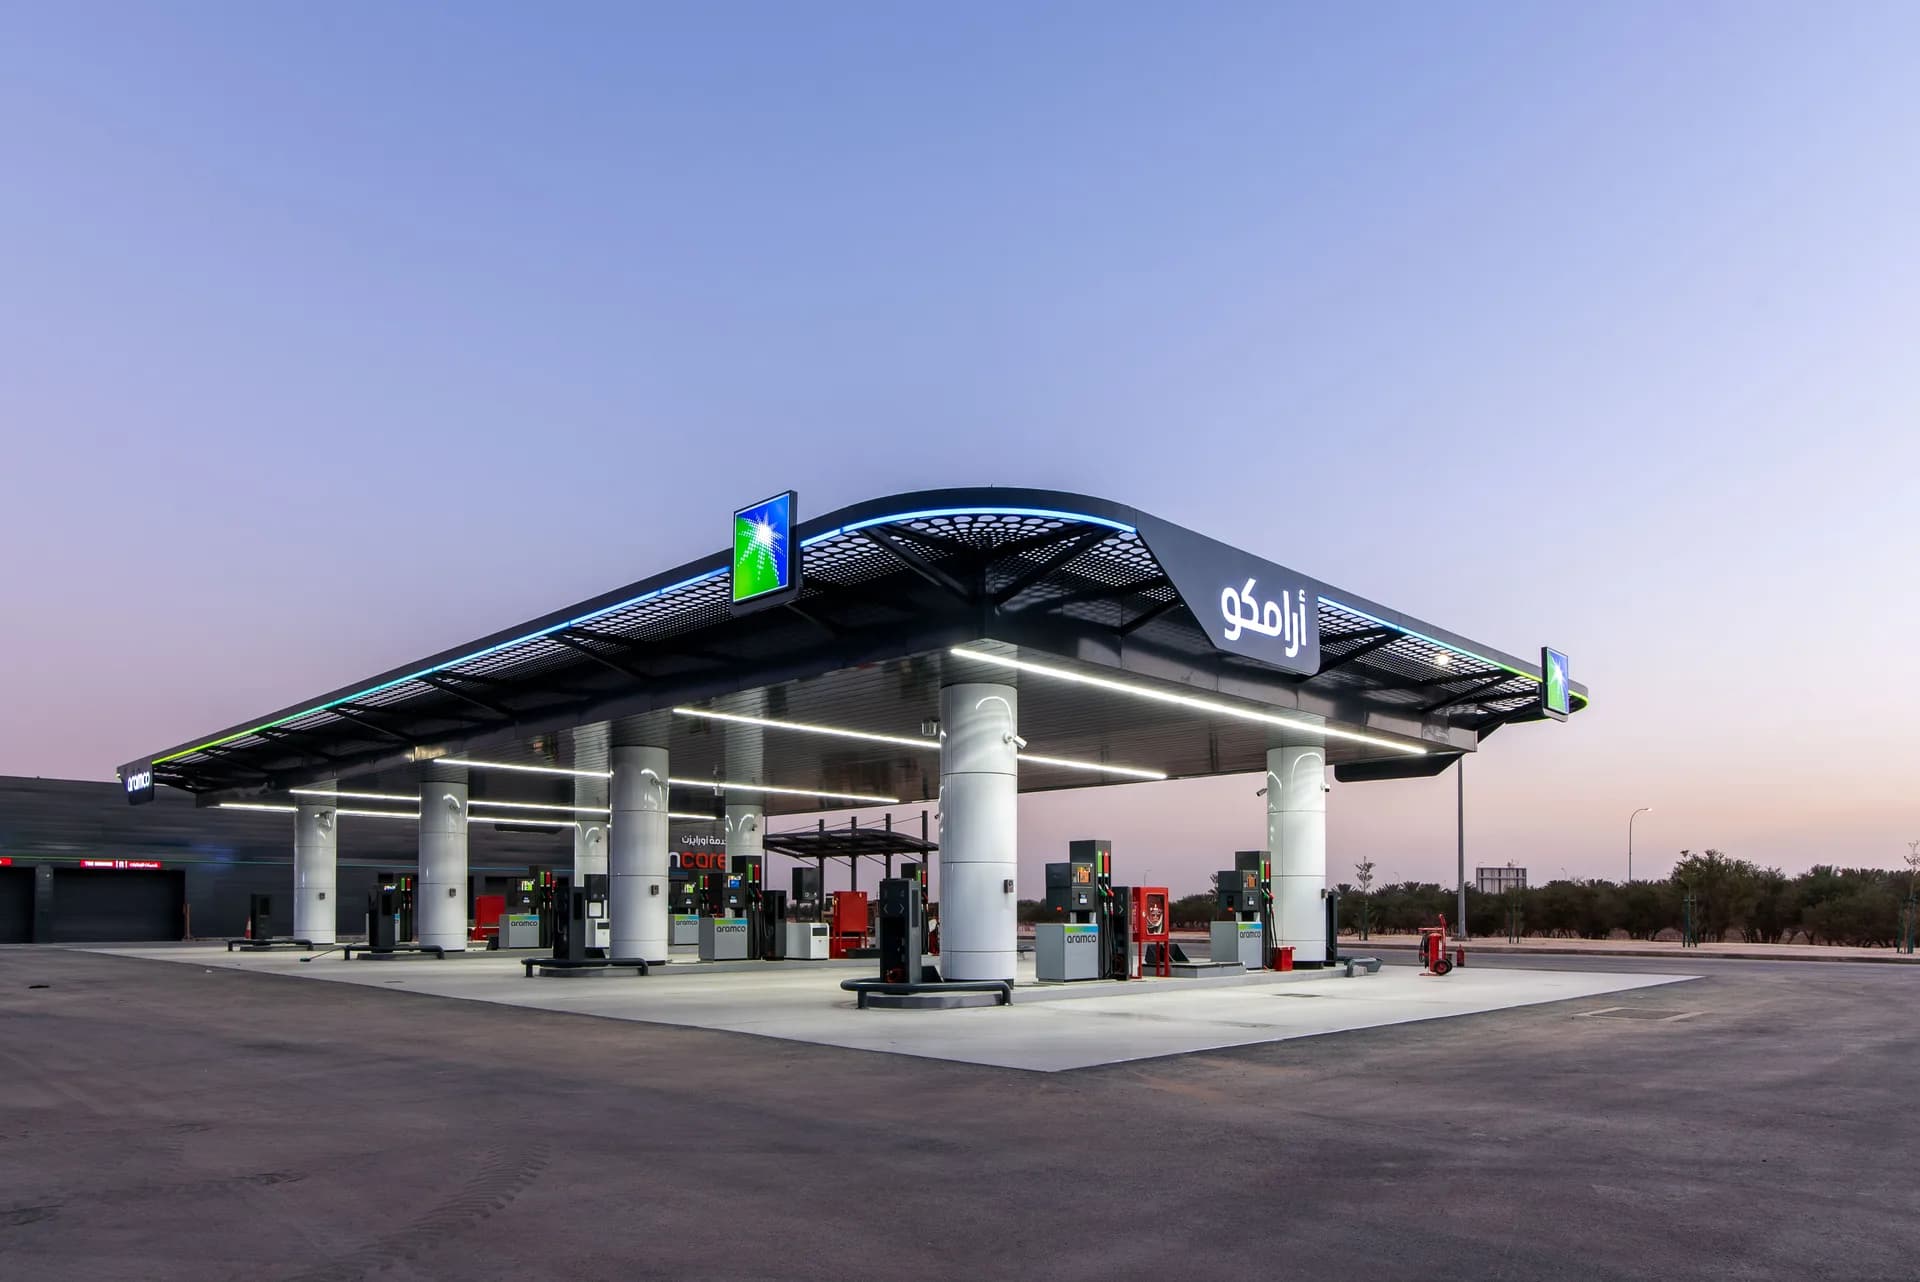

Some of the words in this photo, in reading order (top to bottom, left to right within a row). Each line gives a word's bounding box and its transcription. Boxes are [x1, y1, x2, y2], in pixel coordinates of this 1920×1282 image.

[1221, 577, 1307, 658] أرامكو
[127, 771, 150, 792] aramco
[709, 835, 726, 845] دمة
[1067, 934, 1097, 944] aramco
[1239, 931, 1261, 939] aramco
